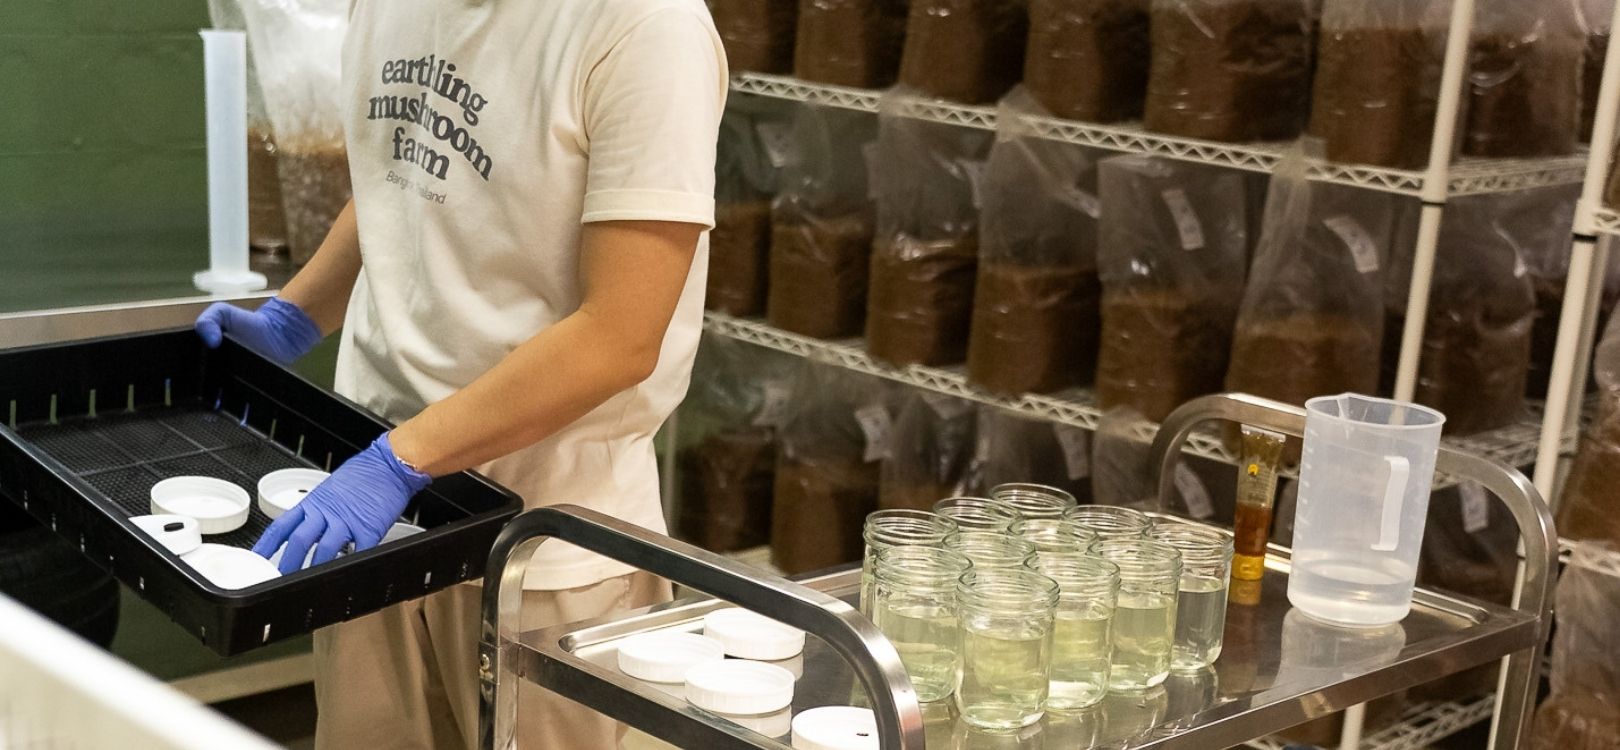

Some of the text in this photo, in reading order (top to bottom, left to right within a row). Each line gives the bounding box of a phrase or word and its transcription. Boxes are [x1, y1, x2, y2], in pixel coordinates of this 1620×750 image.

[381, 54, 488, 126] earthling
[367, 92, 493, 181] mushroom
[392, 126, 450, 180] farm
